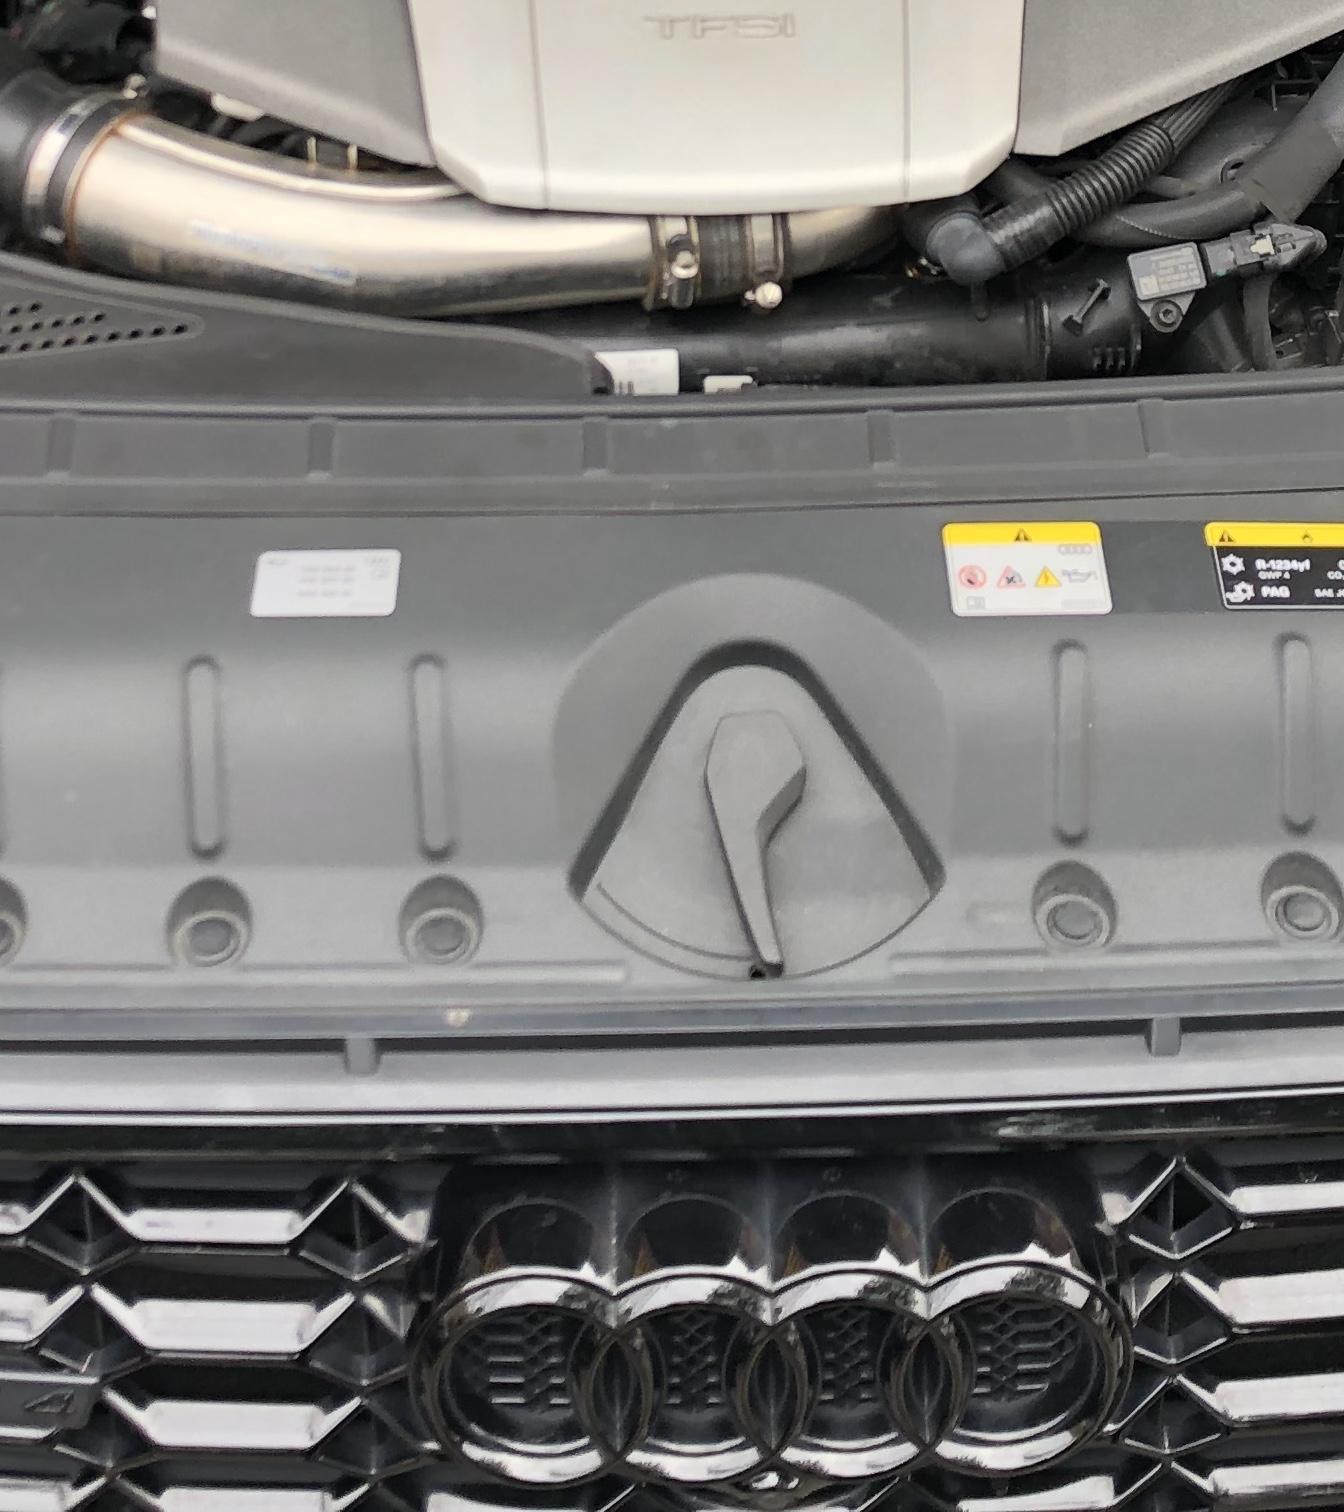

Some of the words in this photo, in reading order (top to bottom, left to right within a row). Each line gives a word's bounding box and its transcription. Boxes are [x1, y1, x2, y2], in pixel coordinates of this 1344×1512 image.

[642, 13, 796, 40] TFSI
[1261, 585, 1291, 598] PAG
[23, 1387, 77, 1415] 4
